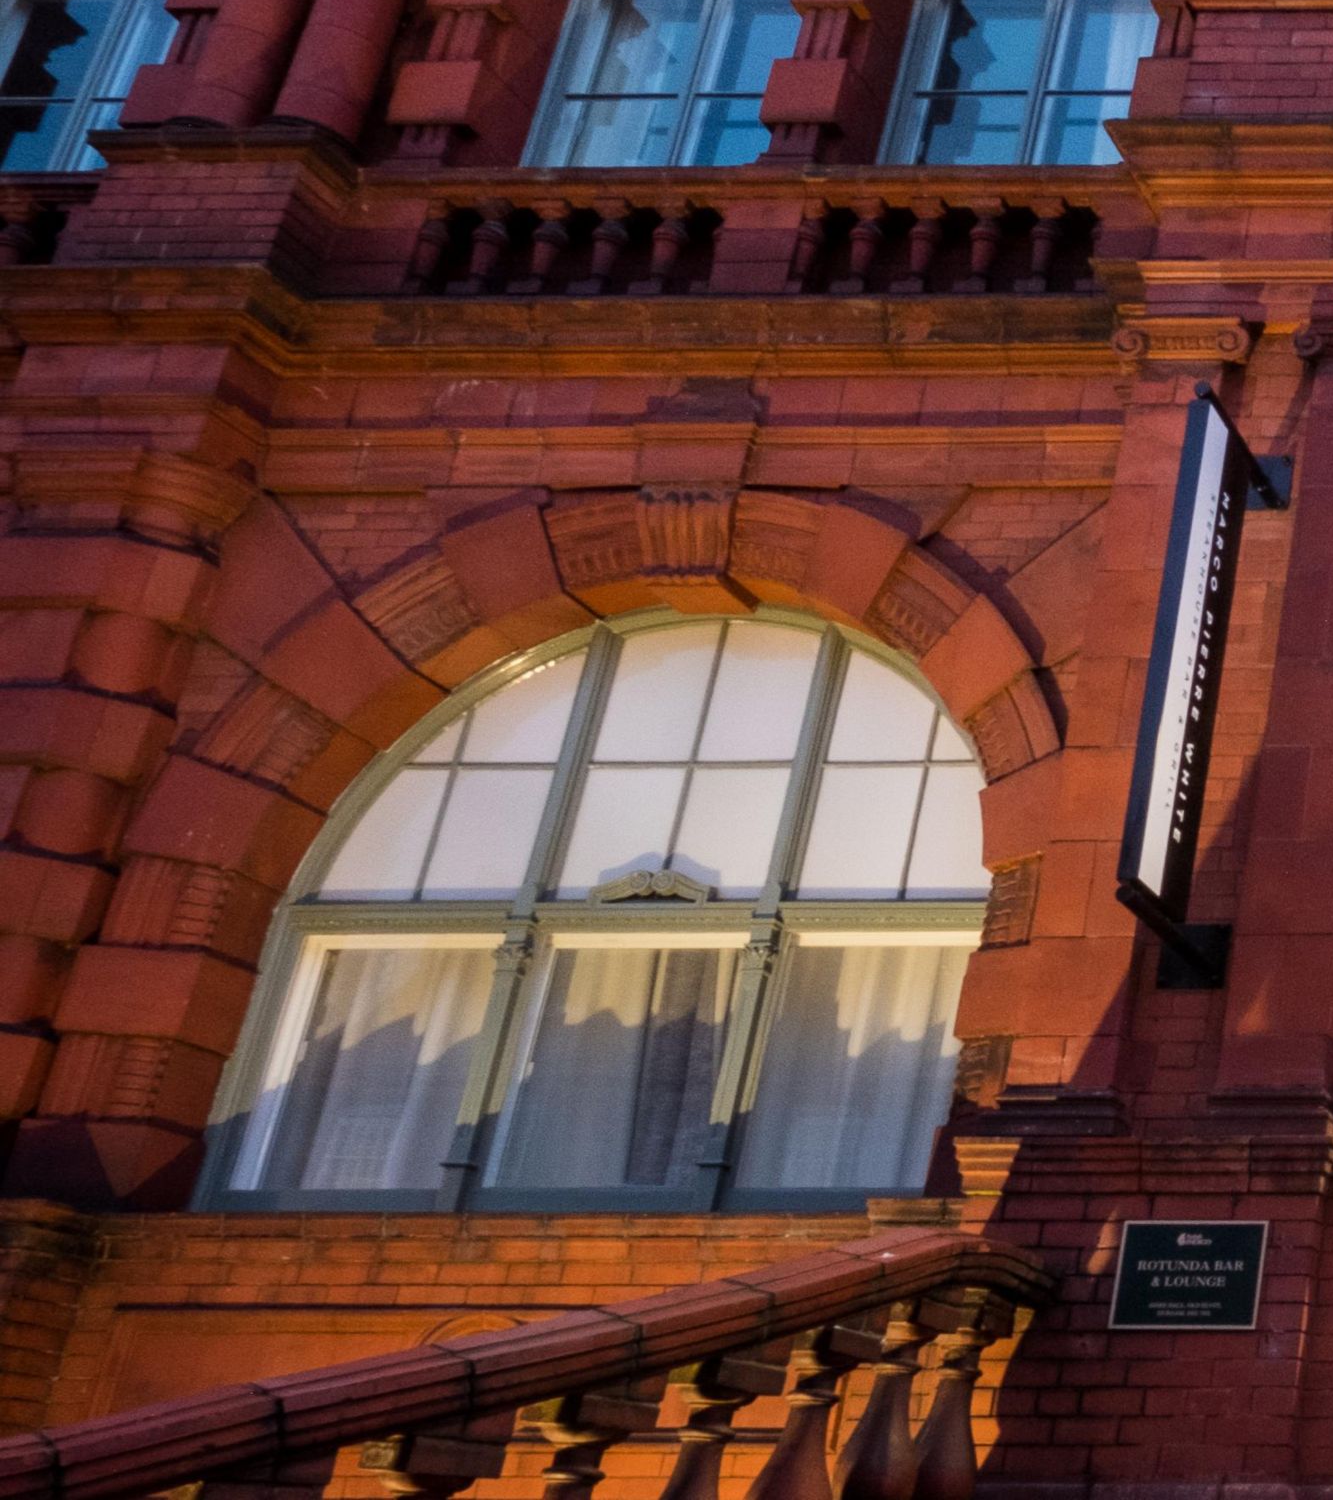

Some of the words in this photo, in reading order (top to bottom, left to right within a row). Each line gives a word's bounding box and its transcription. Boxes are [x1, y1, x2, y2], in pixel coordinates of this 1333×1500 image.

[1191, 495, 1216, 639] STEAKHOUSE
[1210, 491, 1231, 592] MARCO
[1182, 656, 1193, 700] BAR
[1191, 610, 1214, 722] PIERRE
[1165, 742, 1180, 808] GRILL
[1172, 743, 1195, 843] WHITE
[1137, 1260, 1210, 1271] ROTUNDA
[1214, 1260, 1244, 1271] BAR
[1150, 1276, 1160, 1287] &
[1163, 1276, 1226, 1288] LOUNGE
